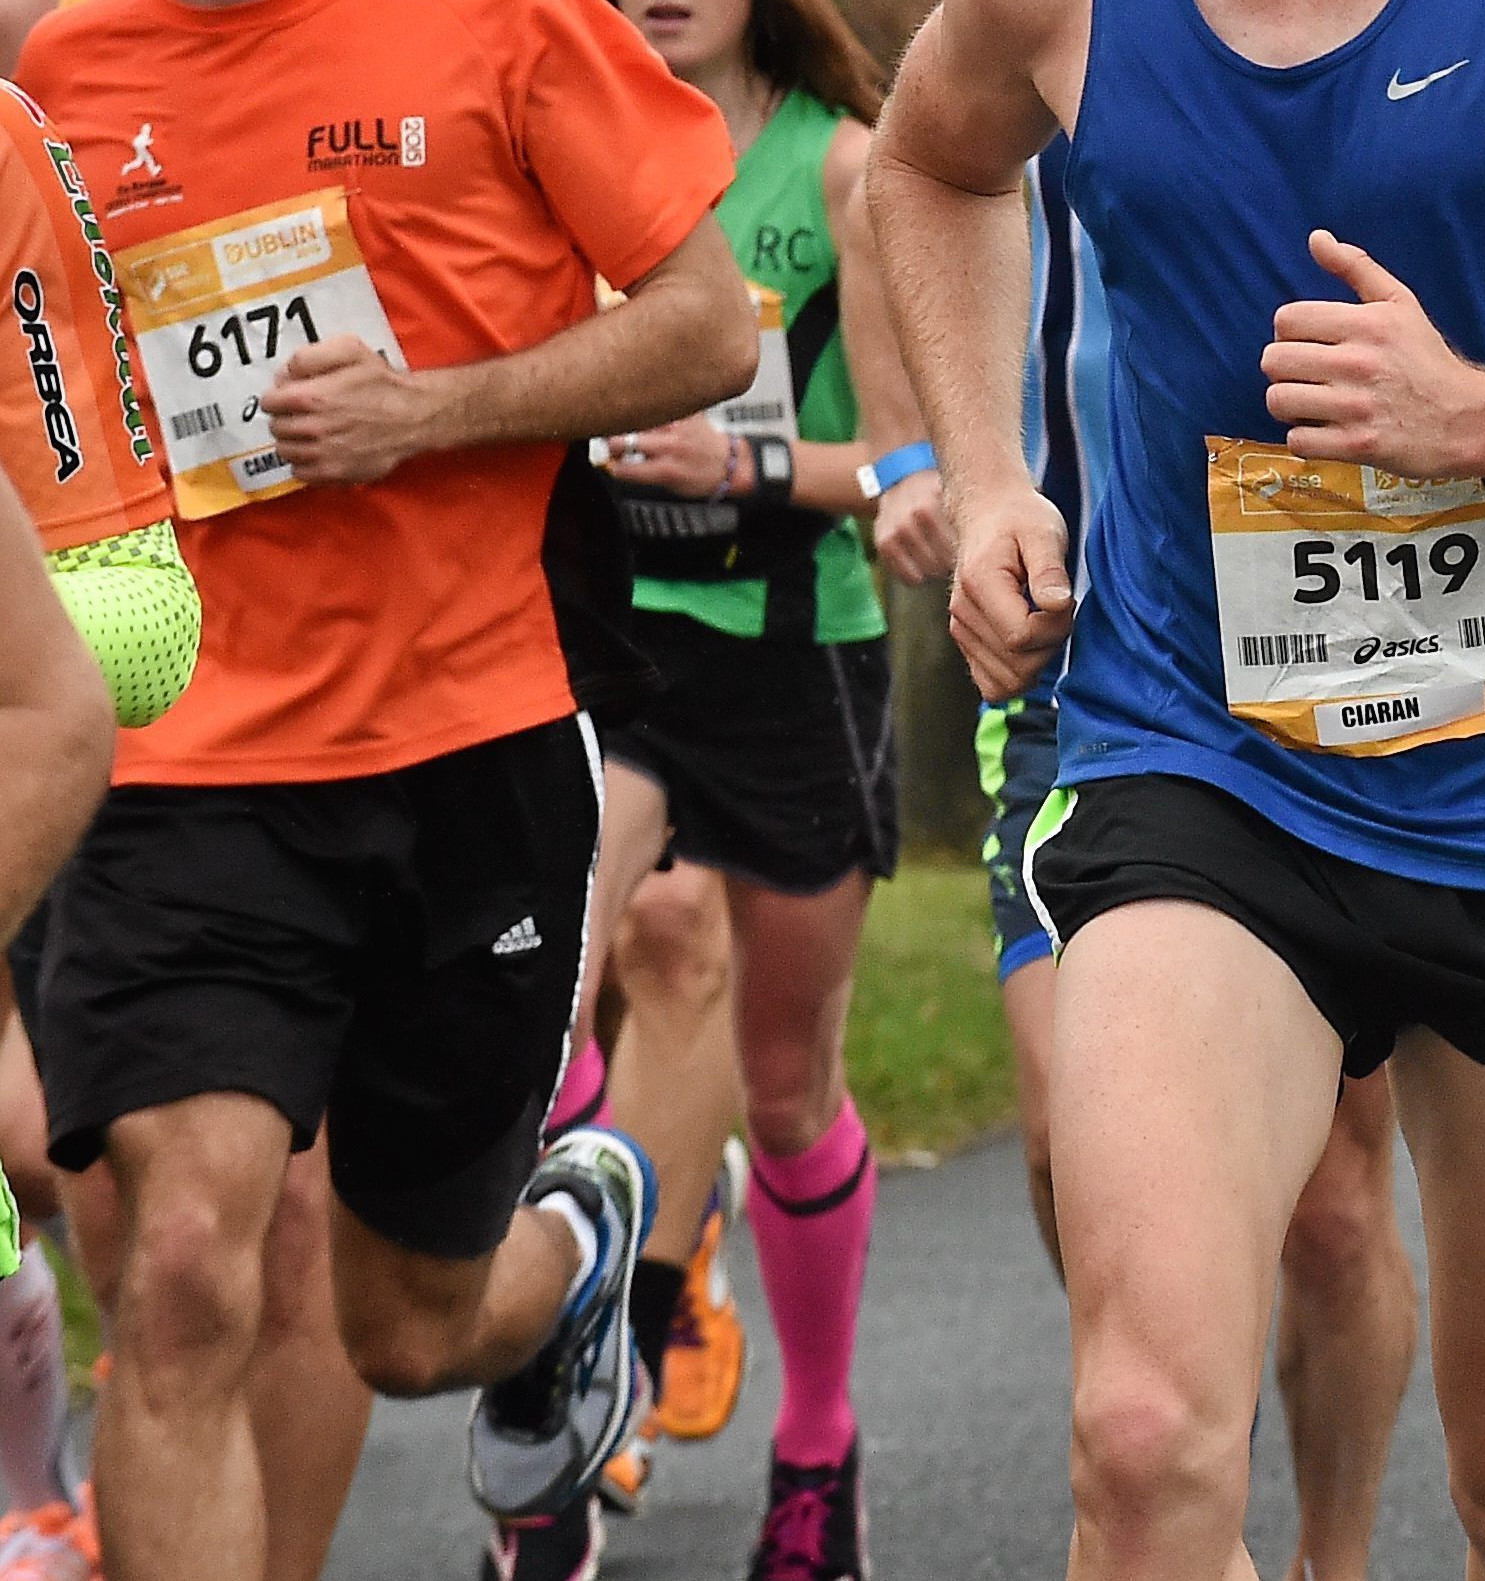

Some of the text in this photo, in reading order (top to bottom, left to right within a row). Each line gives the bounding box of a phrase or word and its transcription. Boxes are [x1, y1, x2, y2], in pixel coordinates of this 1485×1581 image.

[307, 117, 398, 158] FULL
[753, 225, 815, 273] RC
[188, 295, 320, 378] 6171
[12, 268, 83, 483] ORBEA
[1288, 473, 1323, 489] sse
[1293, 532, 1480, 605] 5119
[1382, 633, 1440, 658] asics
[1340, 696, 1421, 729] CIARAN
